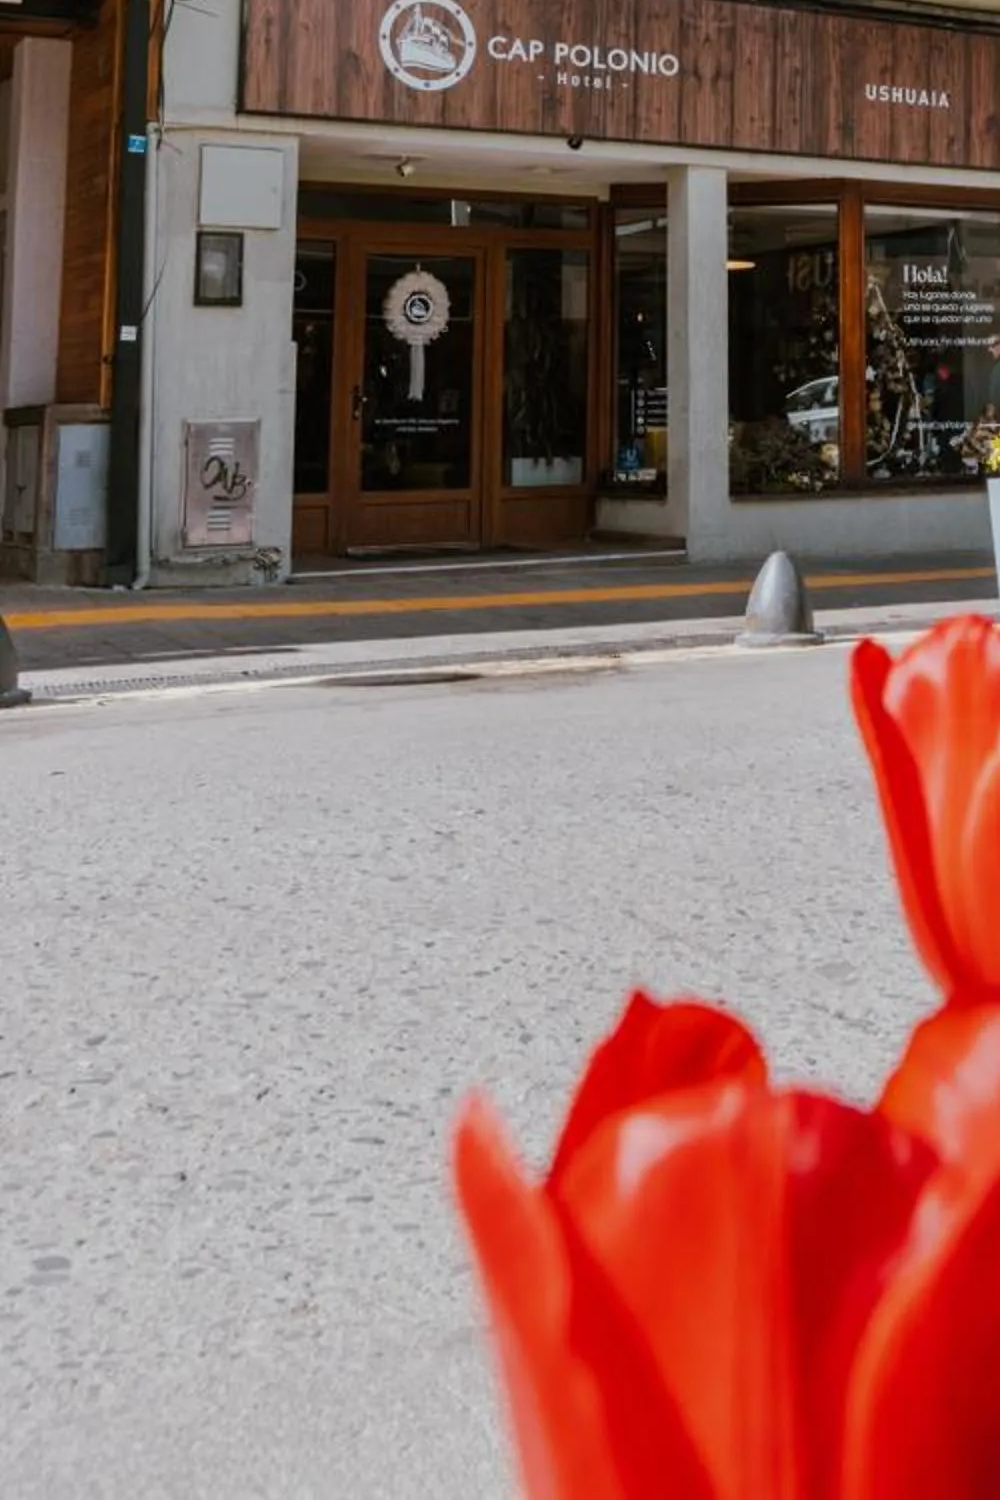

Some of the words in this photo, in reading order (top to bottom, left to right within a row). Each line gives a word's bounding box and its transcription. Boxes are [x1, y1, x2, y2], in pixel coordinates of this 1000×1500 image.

[487, 35, 545, 63] CAP
[553, 42, 680, 77] POLONIO
[556, 71, 612, 90] Hotel
[864, 83, 950, 109] USHUAIA
[903, 264, 948, 284] Hola!
